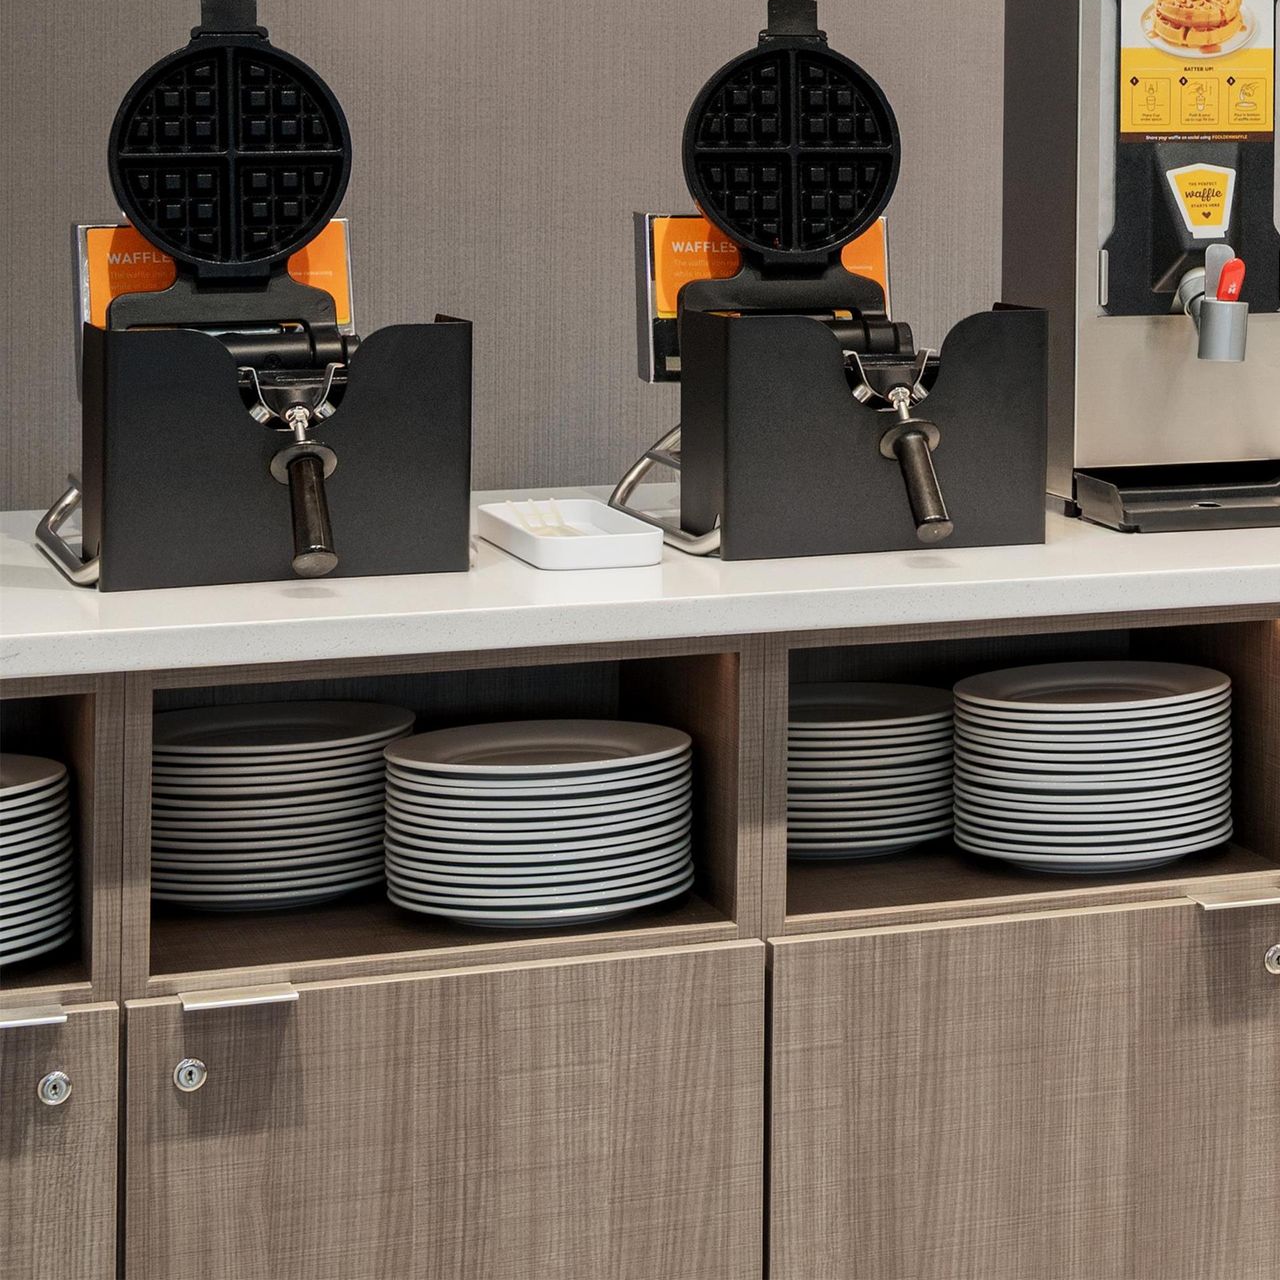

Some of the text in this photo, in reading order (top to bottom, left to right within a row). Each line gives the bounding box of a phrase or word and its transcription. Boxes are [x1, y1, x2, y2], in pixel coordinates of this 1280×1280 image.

[1184, 188, 1222, 202] waffle
[672, 241, 737, 253] WAFFLES
[107, 252, 174, 266] WAFFLE
